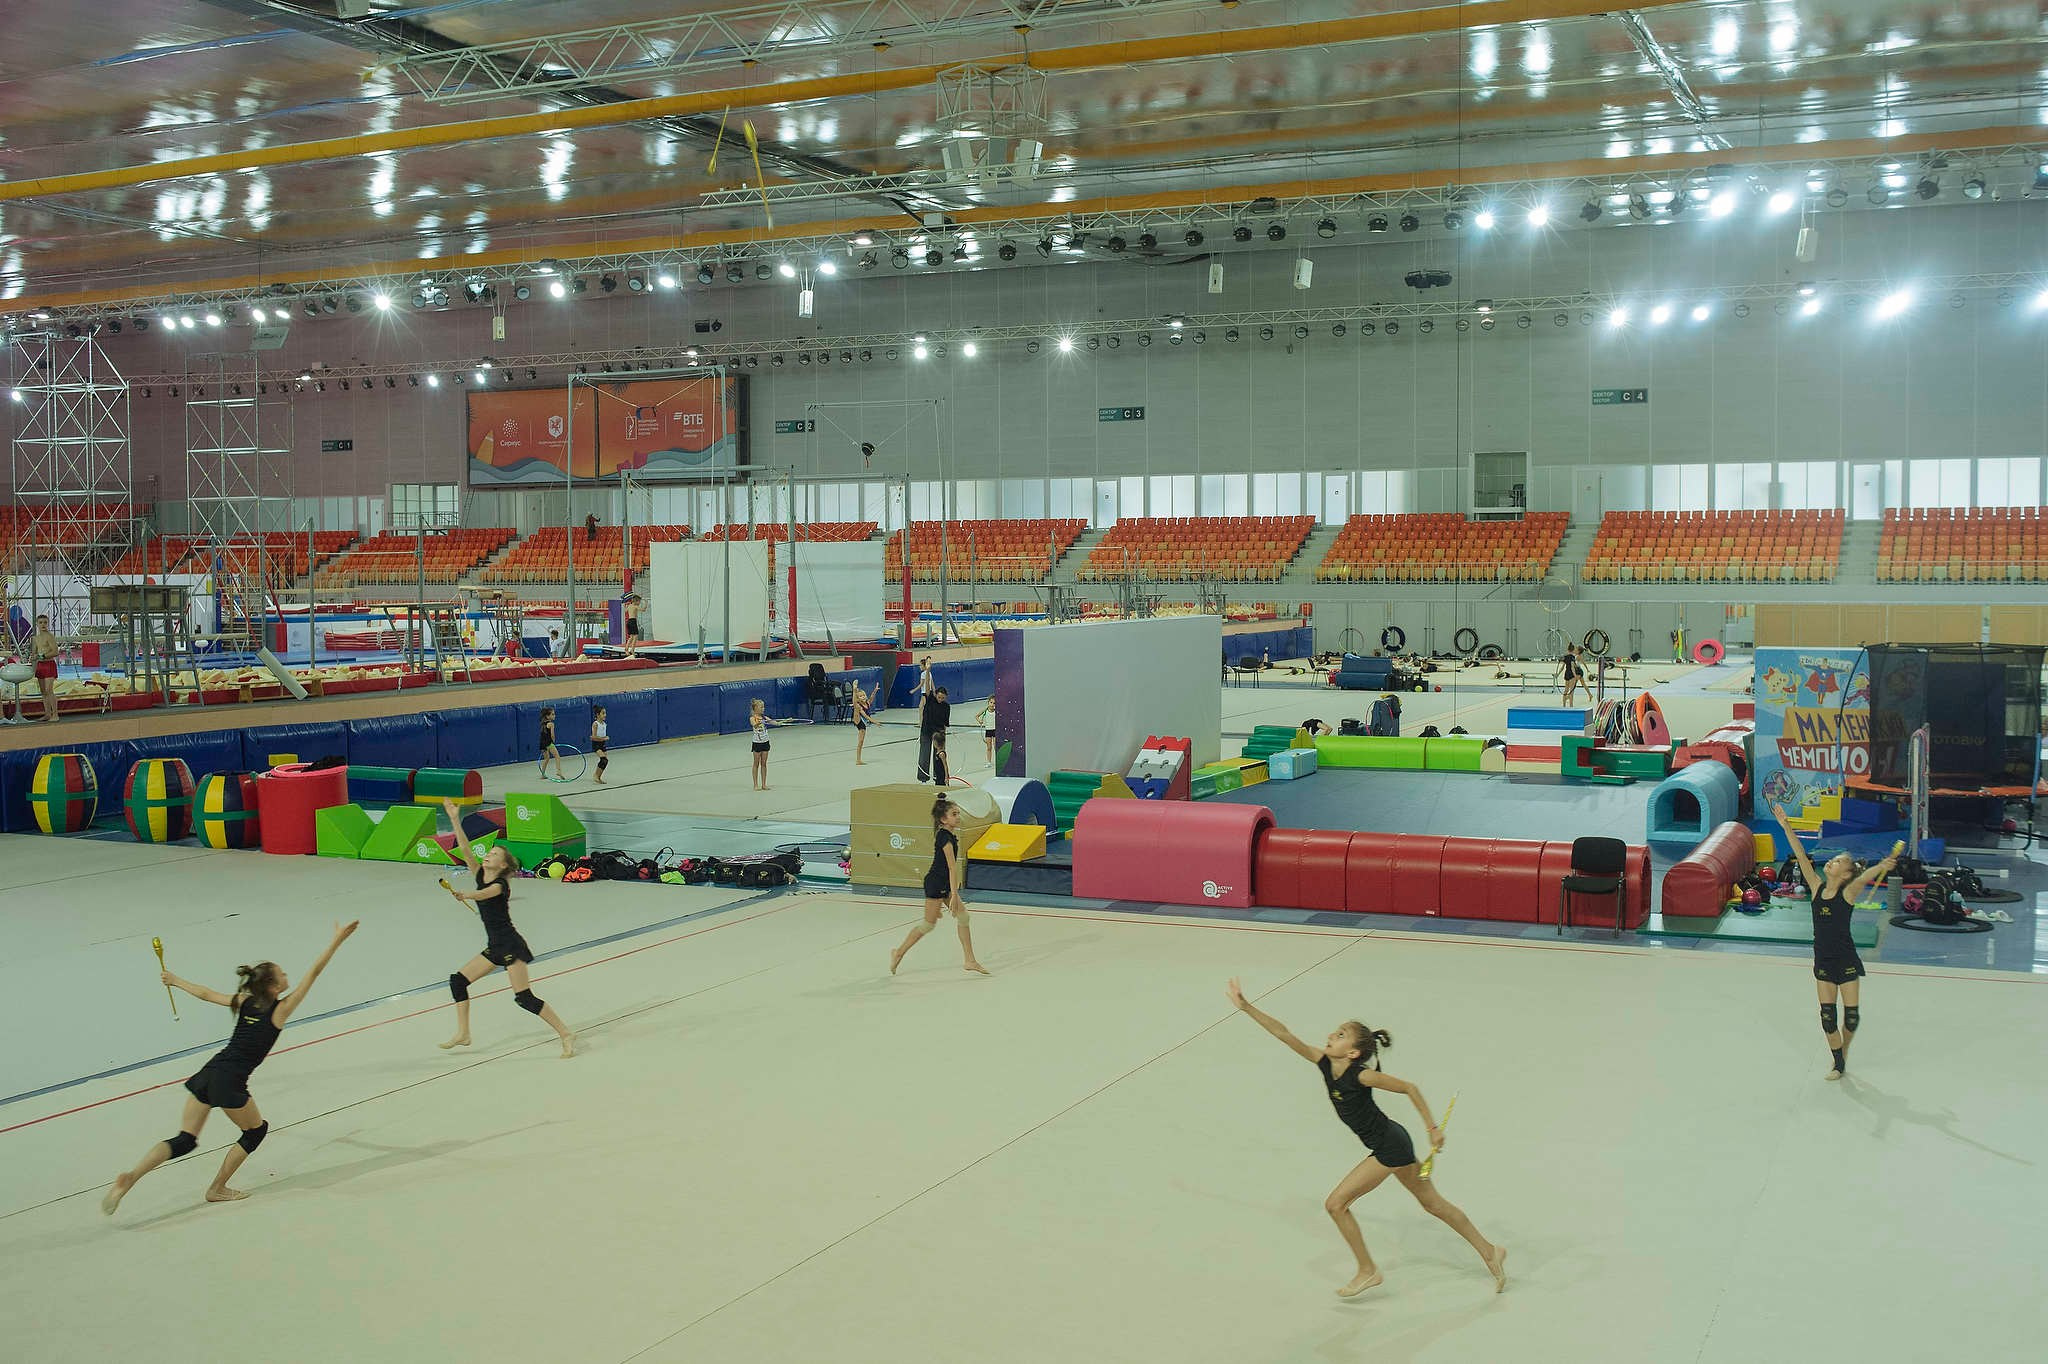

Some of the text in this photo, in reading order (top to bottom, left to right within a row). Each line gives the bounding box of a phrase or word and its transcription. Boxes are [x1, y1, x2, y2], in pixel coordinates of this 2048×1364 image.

[1637, 392, 1643, 400] 4
[683, 413, 704, 426] ВТБ
[499, 439, 521, 448] Сириус
